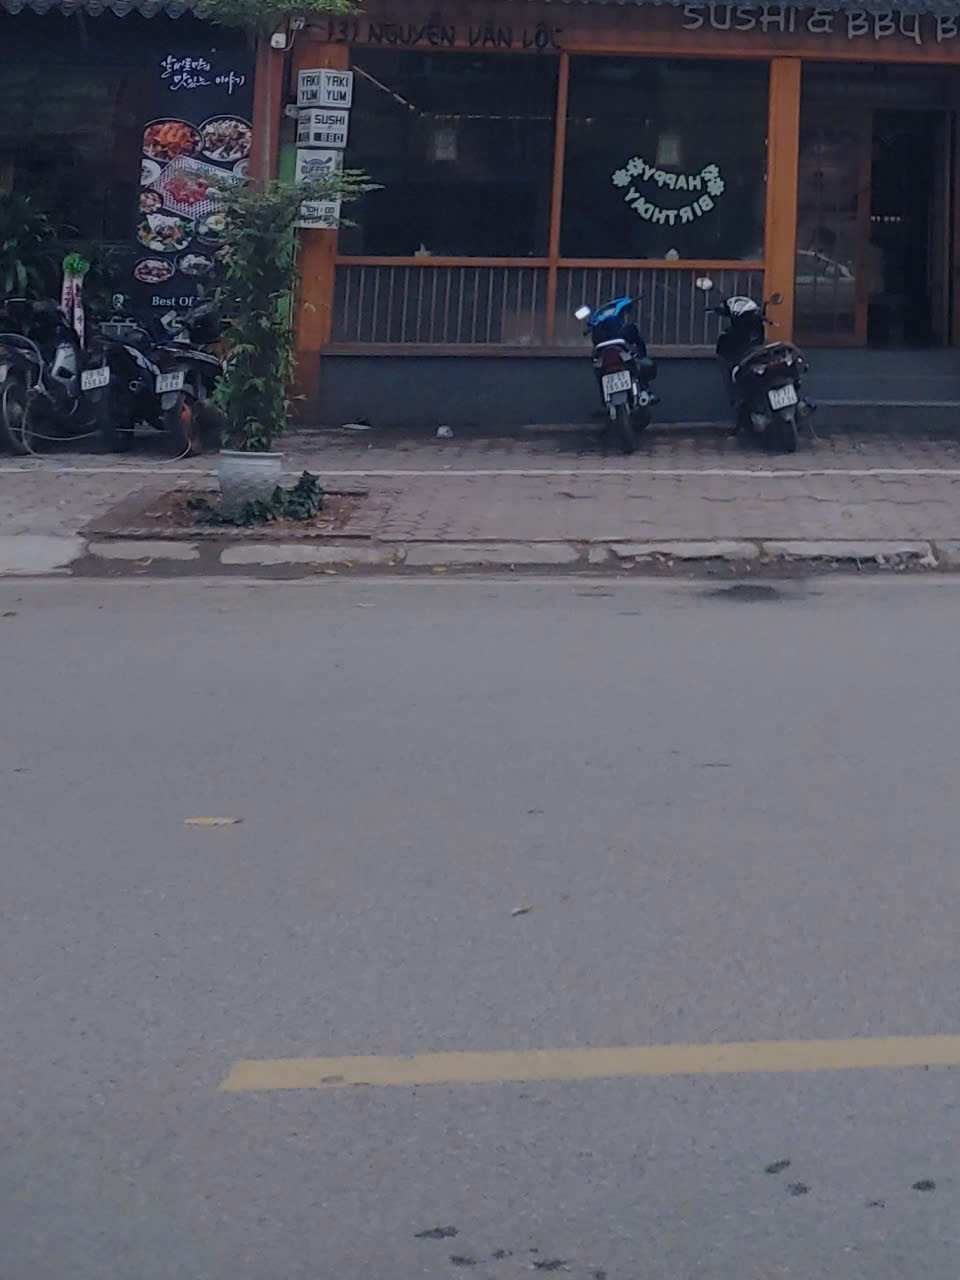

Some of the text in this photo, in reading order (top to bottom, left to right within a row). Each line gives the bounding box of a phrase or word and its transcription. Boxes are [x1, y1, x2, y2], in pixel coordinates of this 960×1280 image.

[683, 4, 796, 32] SUSHI
[807, 7, 834, 33] &
[846, 8, 922, 45] BBQ
[301, 75, 320, 87] YAKI
[326, 75, 349, 87] YAKI
[326, 89, 347, 101] YUM
[315, 114, 346, 126] SUSHI
[152, 296, 195, 307] Best Of
